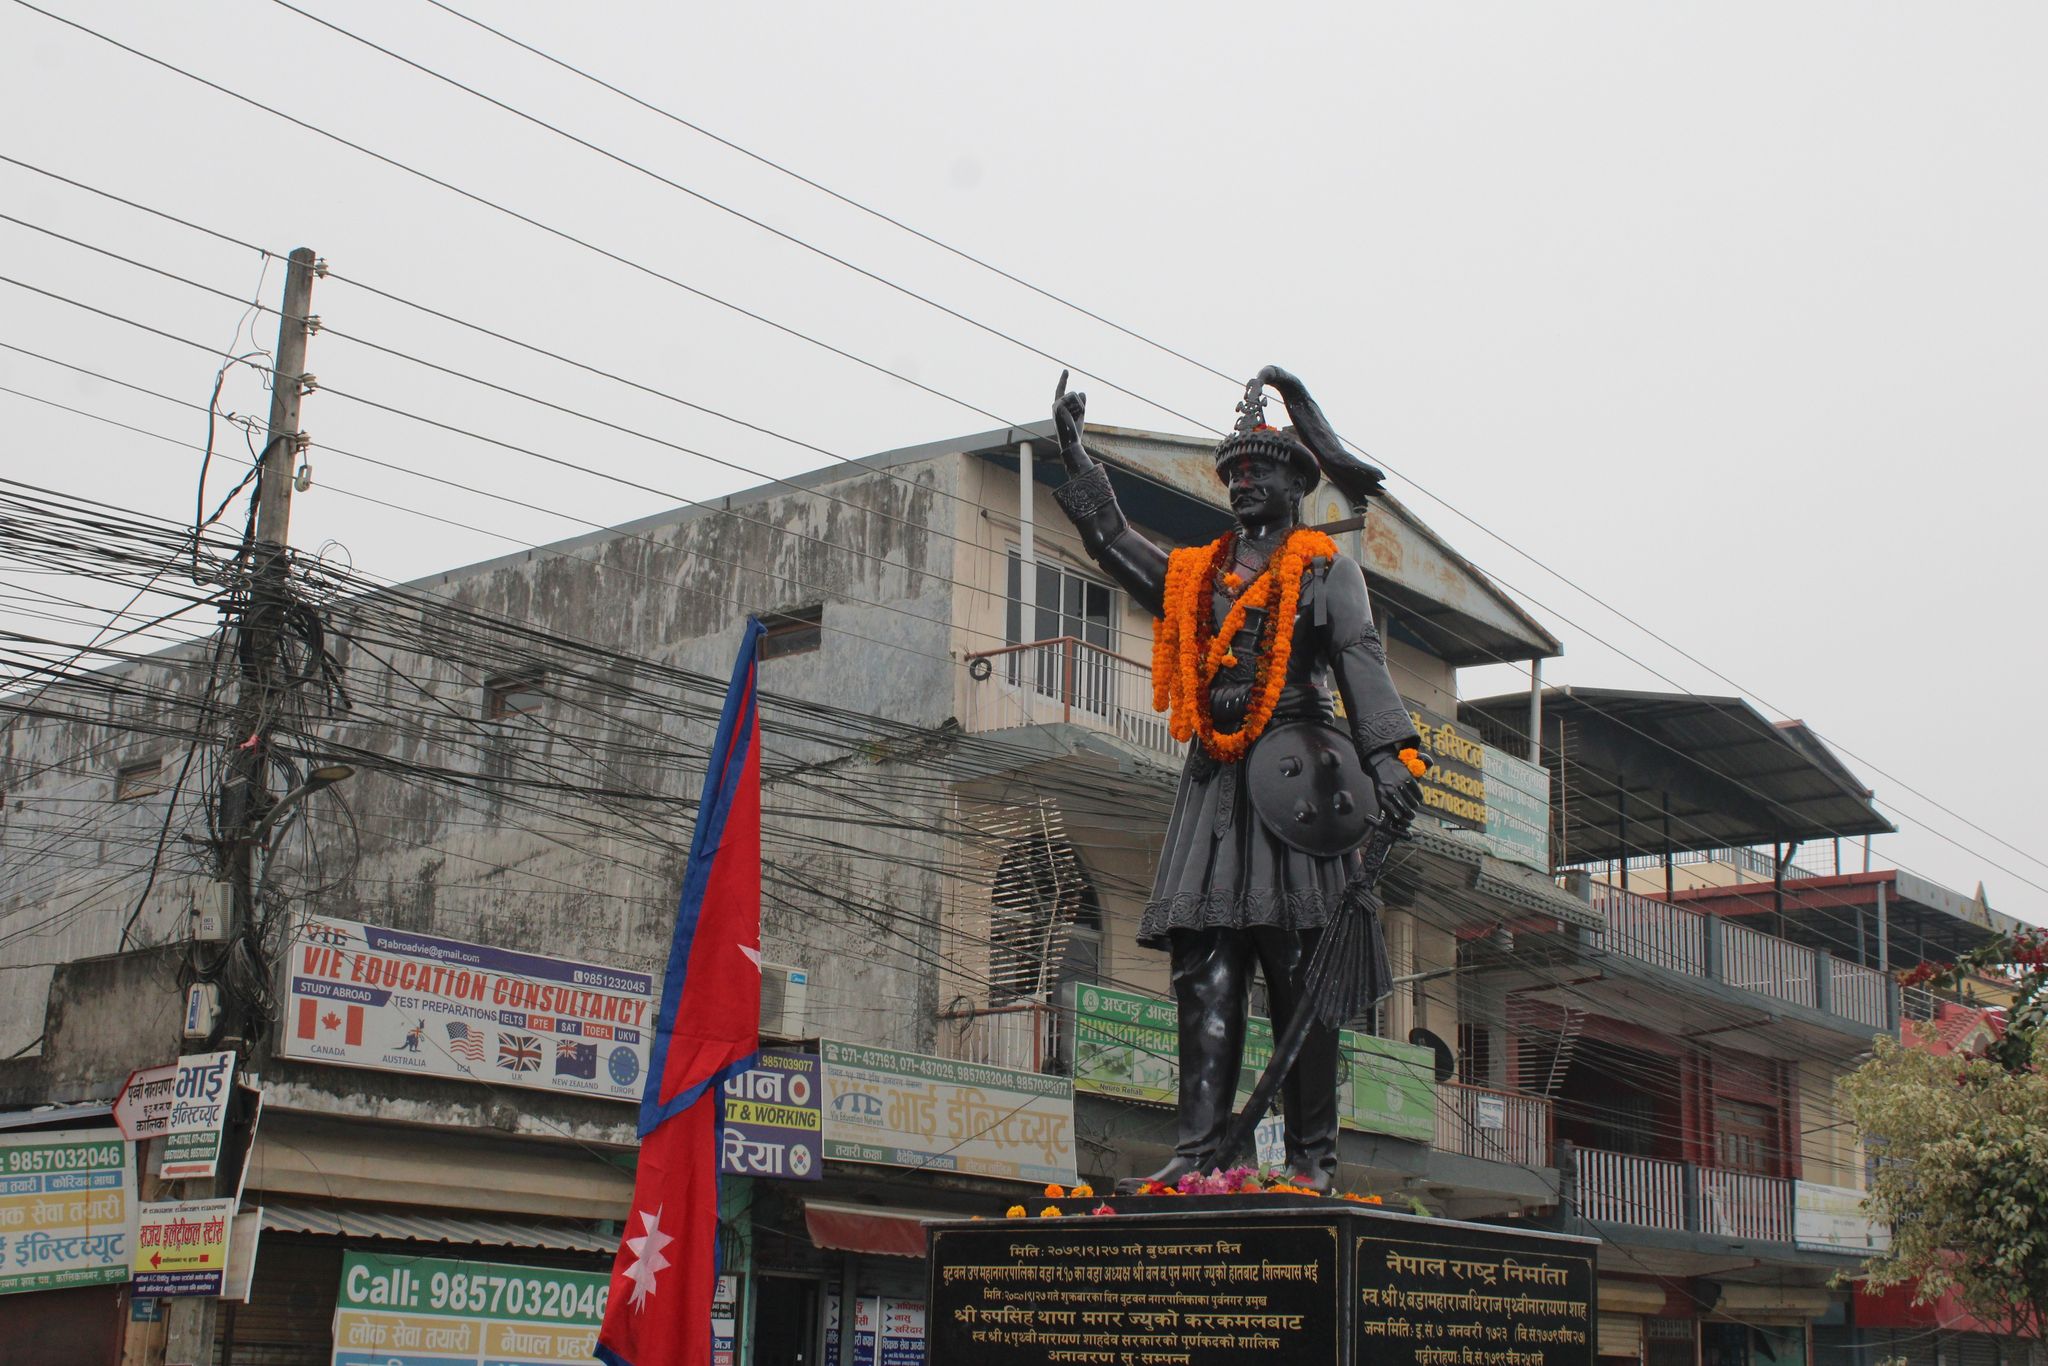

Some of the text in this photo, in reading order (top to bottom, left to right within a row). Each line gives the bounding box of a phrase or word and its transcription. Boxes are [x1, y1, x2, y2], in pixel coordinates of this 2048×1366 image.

[1421, 784, 1487, 824] 857082035
[387, 940, 480, 964] abroadvie@gmail.com
[301, 981, 372, 1001] STUDY ABROAD
[303, 946, 647, 1026] VIE EDUCATION CONSULTANCY
[583, 971, 646, 994] 9851232045
[394, 995, 497, 1022] TEST PREPARATIONS
[500, 1013, 524, 1027] IELTS
[532, 1018, 549, 1030] PTE
[561, 1021, 577, 1033] SAT
[586, 1025, 610, 1039] TOEFL
[618, 1030, 636, 1043] UKVI
[1079, 1018, 1179, 1053] PHYSIOTHERAP
[310, 1044, 346, 1057] CANADA
[382, 1054, 426, 1068] AUSTRALIA
[456, 1063, 471, 1074] USA
[762, 1055, 814, 1072] 9857039077
[175, 1054, 229, 1103] भाई
[552, 1077, 599, 1091] NEW ZEALAND
[610, 1085, 635, 1096] EUROPE
[740, 1103, 751, 1121] &
[755, 1105, 817, 1128] WORKING
[887, 1084, 938, 1145] भाई
[10, 1146, 120, 1172] 9857032046
[835, 1143, 861, 1158] तयारी
[10, 1177, 37, 1193] तयारी
[31, 1194, 121, 1226] सेवा तयारी
[1122, 1243, 1143, 1256] गते
[1146, 1244, 1214, 1259] बुधबारका
[1216, 1240, 1242, 1255] दिन
[1039, 1265, 1055, 1283] वडा
[1086, 1265, 1103, 1283] वडा
[1104, 1265, 1131, 1282] अध्यक्ष
[1133, 1260, 1145, 1282] श्री
[1182, 1265, 1201, 1282] मगर
[1203, 1261, 1227, 1287] ज्युको
[1229, 1264, 1260, 1285] हातबाट
[1262, 1259, 1302, 1281] शिलन्यास
[1303, 1259, 1319, 1284] भई
[1386, 1250, 1569, 1286] नेपाल राष्ट्र निर्माता
[346, 1264, 610, 1320] Call: 9857032046
[1103, 1290, 1119, 1303] दिन
[1120, 1293, 1146, 1308] बुटवल
[1381, 1283, 1398, 1307] श्री
[1568, 1302, 1588, 1322] शाह
[954, 1304, 1305, 1331] श्री रुपसिंह थापा मगर ज्युको करकमलबाट
[348, 1316, 472, 1351] लोक सेवा तयारी
[988, 1328, 1003, 1343] श्री
[1038, 1334, 1081, 1345] नारायण
[1083, 1331, 1119, 1348] शाहदेव
[1122, 1332, 1178, 1347] सरकारको
[1238, 1333, 1281, 1350] शालिक
[1364, 1321, 1386, 1337] जन्म
[1447, 1322, 1483, 1339] जनवरी
[501, 1331, 552, 1355] नेपाल
[1048, 1350, 1115, 1364] अनावरण
